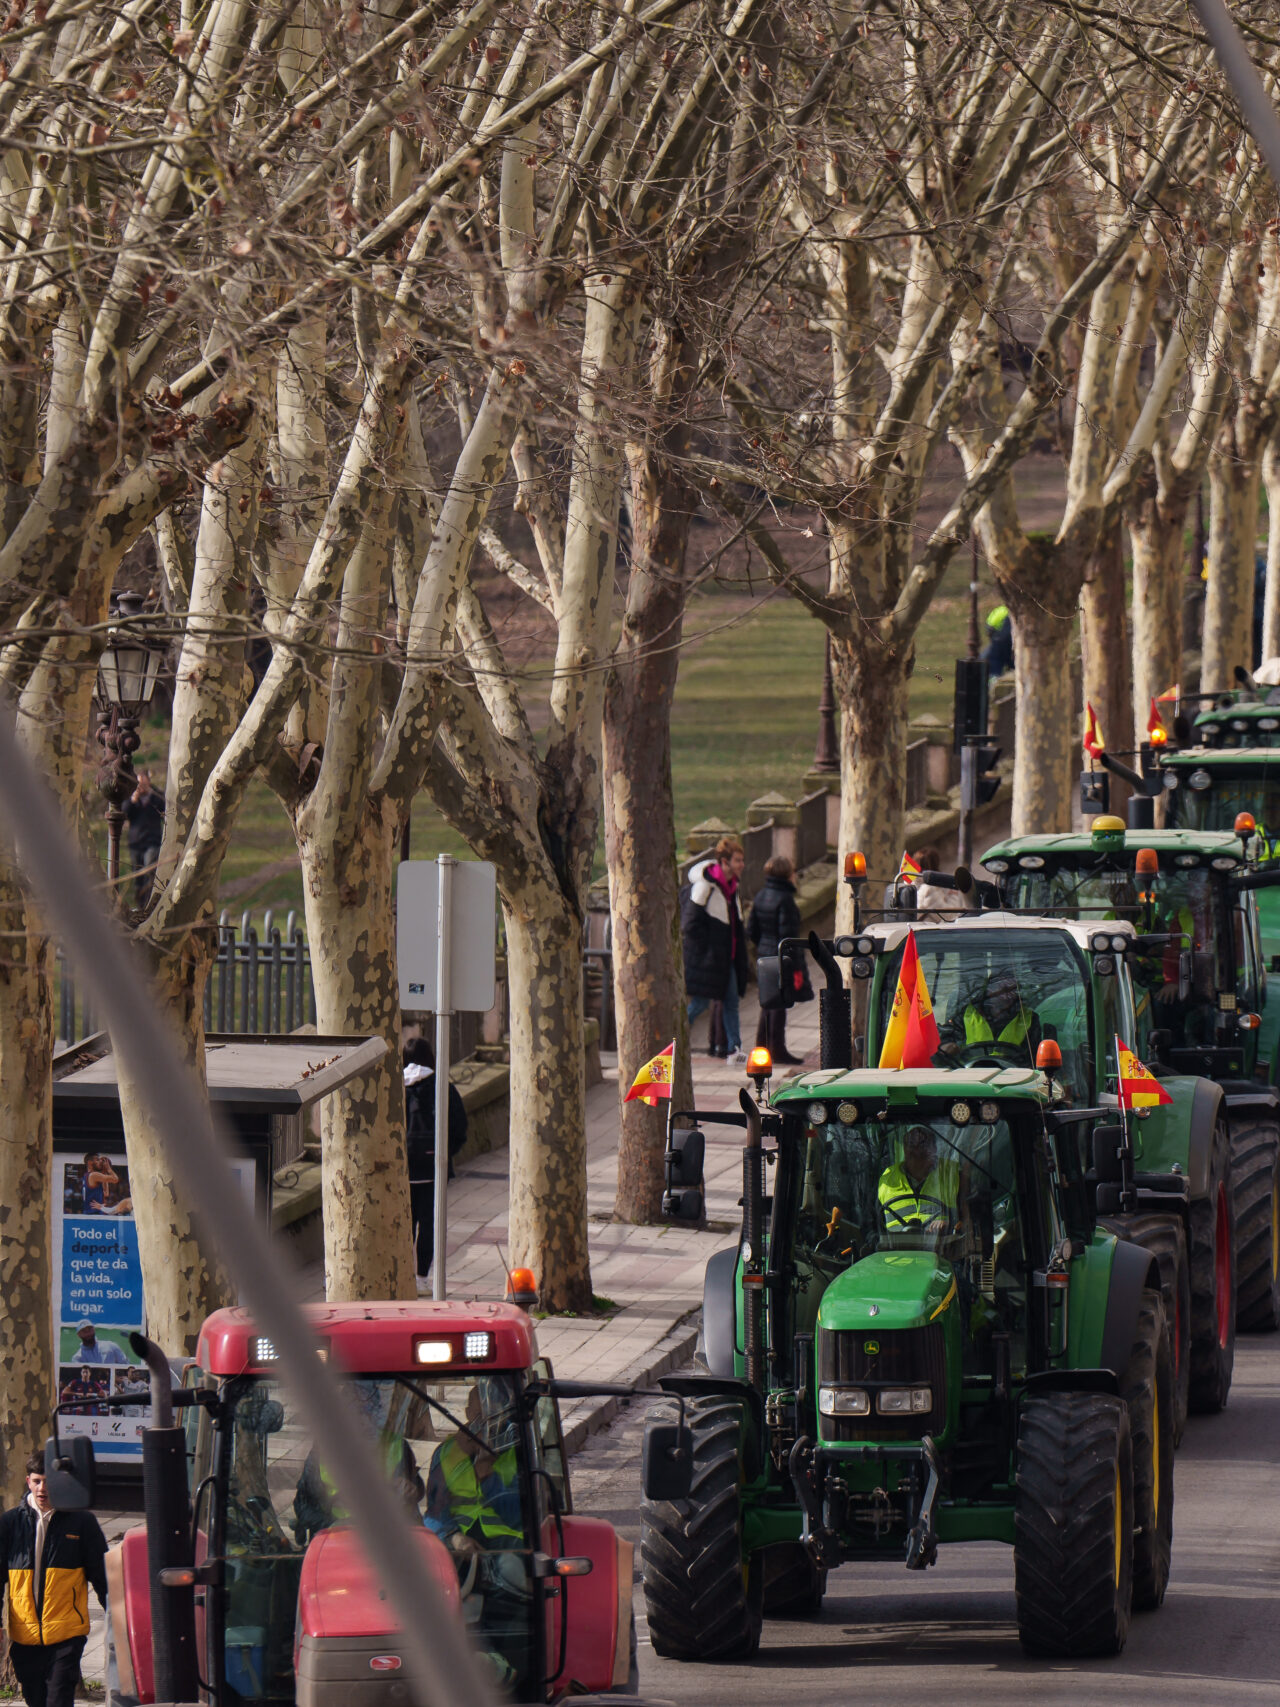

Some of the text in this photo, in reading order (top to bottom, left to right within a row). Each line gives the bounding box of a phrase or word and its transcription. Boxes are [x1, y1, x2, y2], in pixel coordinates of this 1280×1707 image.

[72, 1227, 117, 1240] Todo el
[72, 1241, 128, 1256] deporte
[71, 1258, 128, 1271] que te da
[71, 1271, 114, 1286] la vida,
[70, 1287, 132, 1299] en un solo
[70, 1301, 104, 1315] lugar.
